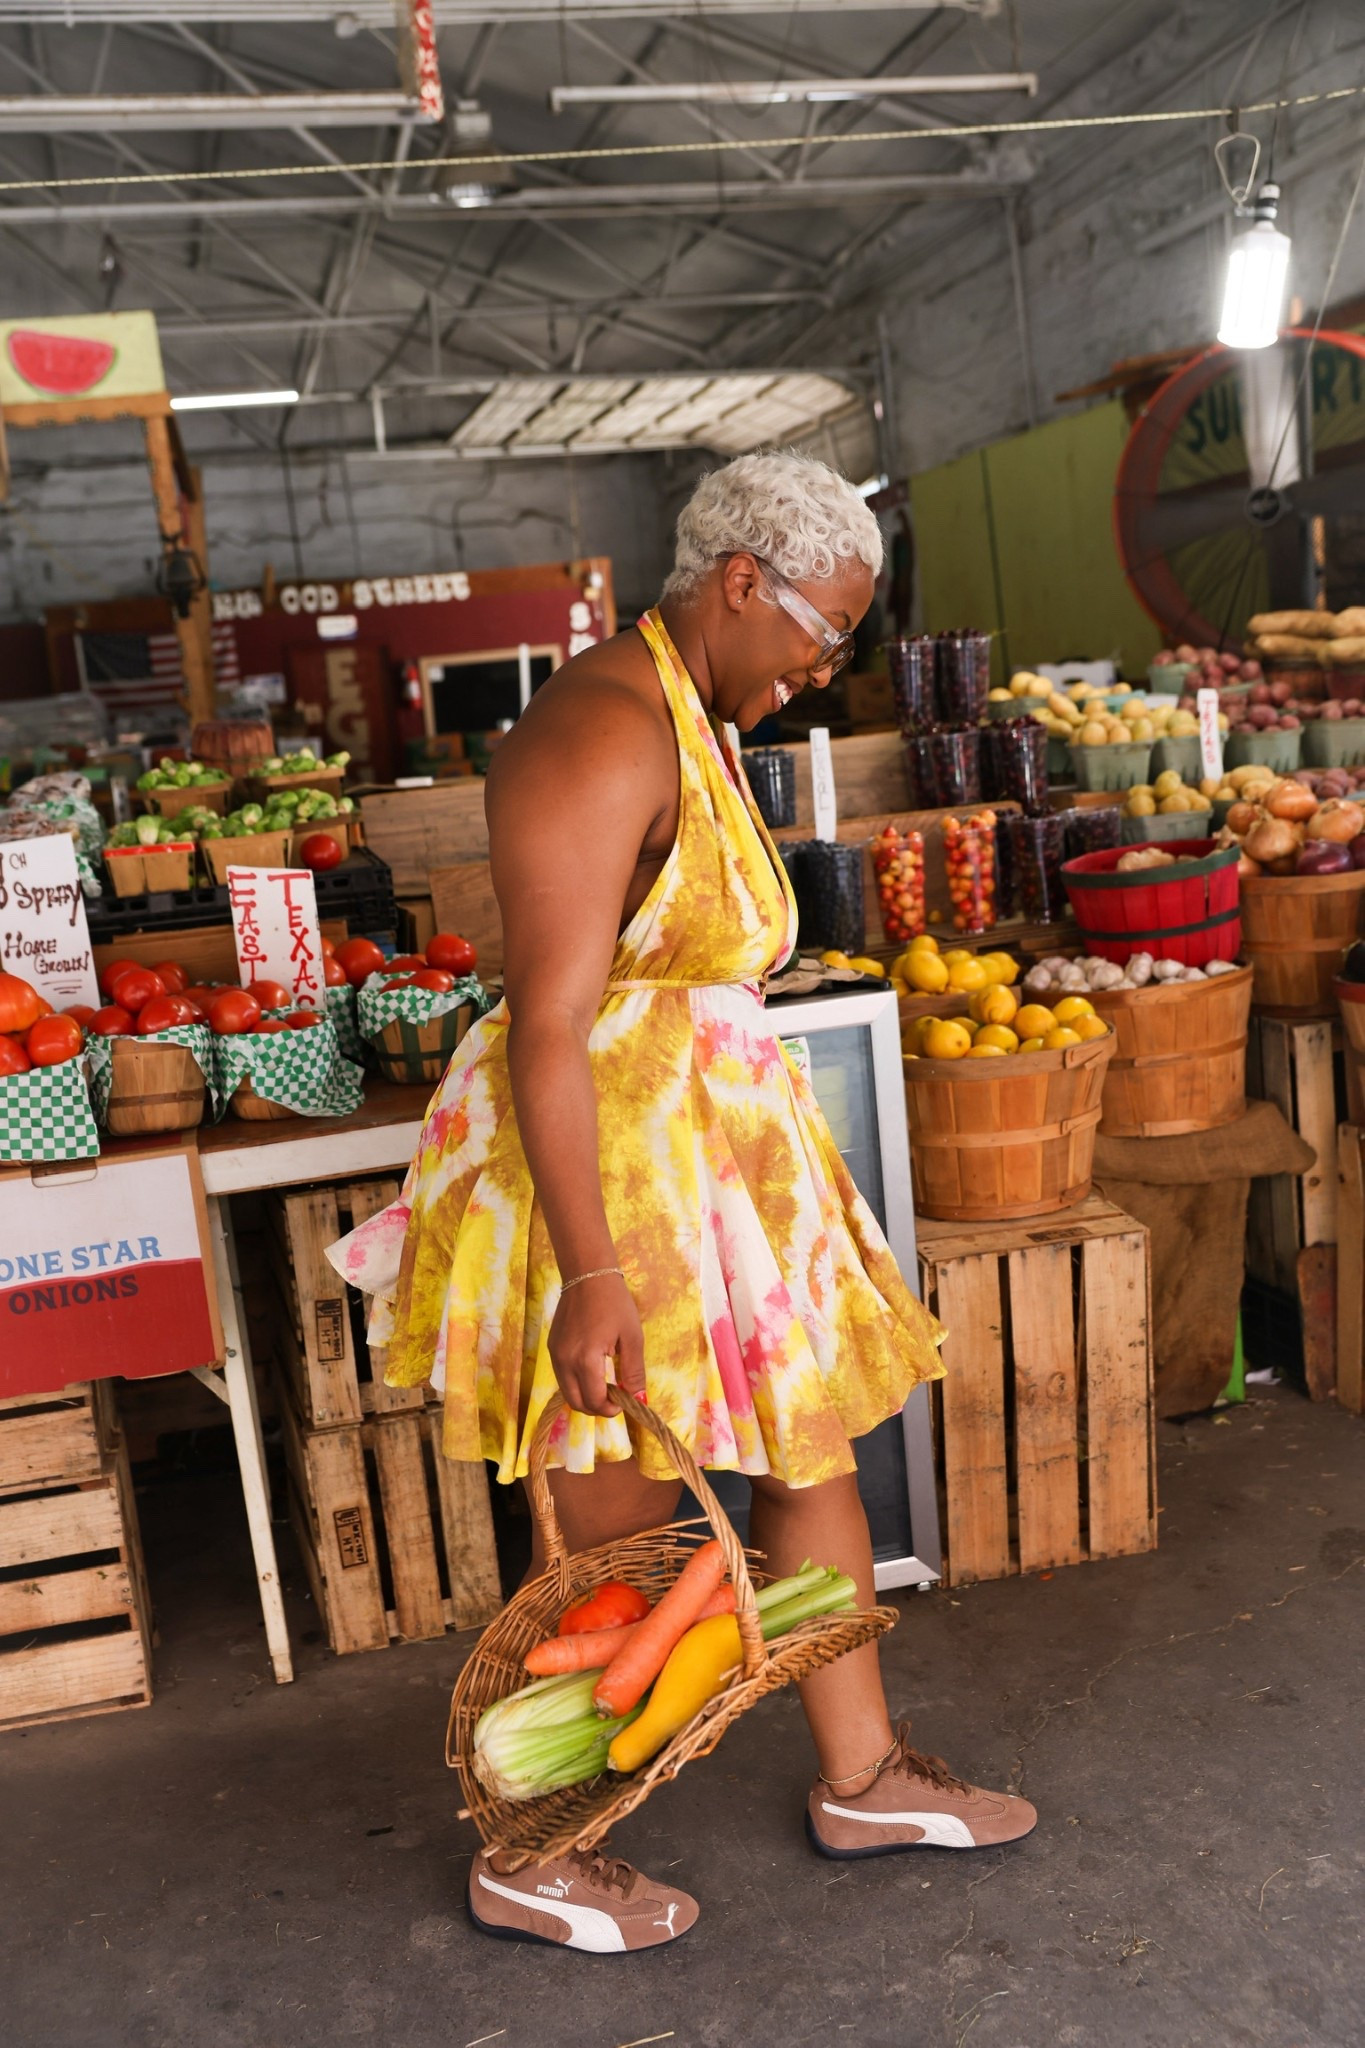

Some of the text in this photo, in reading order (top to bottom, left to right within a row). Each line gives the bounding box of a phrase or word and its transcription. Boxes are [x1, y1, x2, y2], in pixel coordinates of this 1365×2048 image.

[228, 871, 267, 984] EAST
[4, 931, 57, 959] HOME
[34, 951, 90, 974] GROWN
[71, 1236, 162, 1271] STAR
[8, 1274, 139, 1315] ONIONS
[322, 1329, 331, 1345] HT
[342, 1537, 353, 1552] HT
[537, 1884, 564, 1898] PUMA
